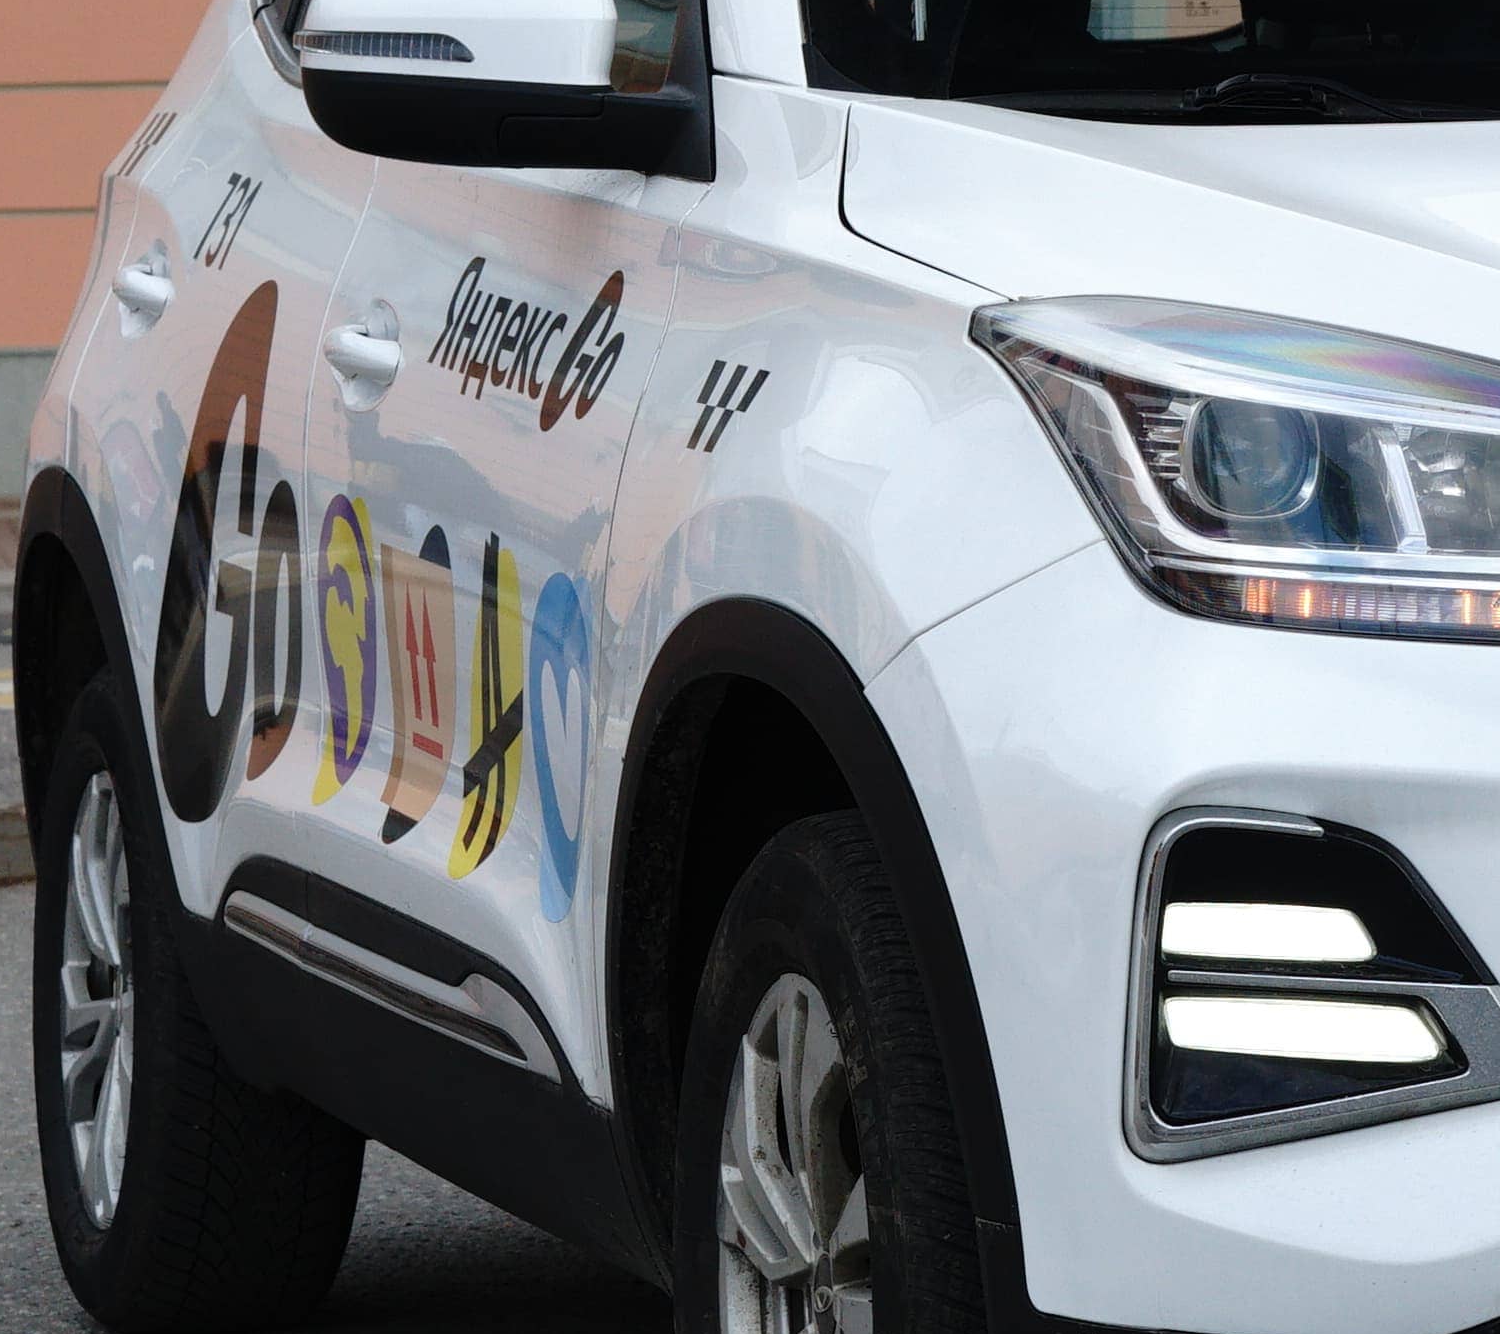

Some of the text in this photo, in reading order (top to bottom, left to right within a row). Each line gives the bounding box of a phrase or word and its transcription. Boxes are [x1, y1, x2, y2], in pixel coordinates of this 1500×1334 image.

[193, 172, 262, 270] 731
[428, 256, 625, 432] Яндекс Go
[153, 279, 302, 824] Go
